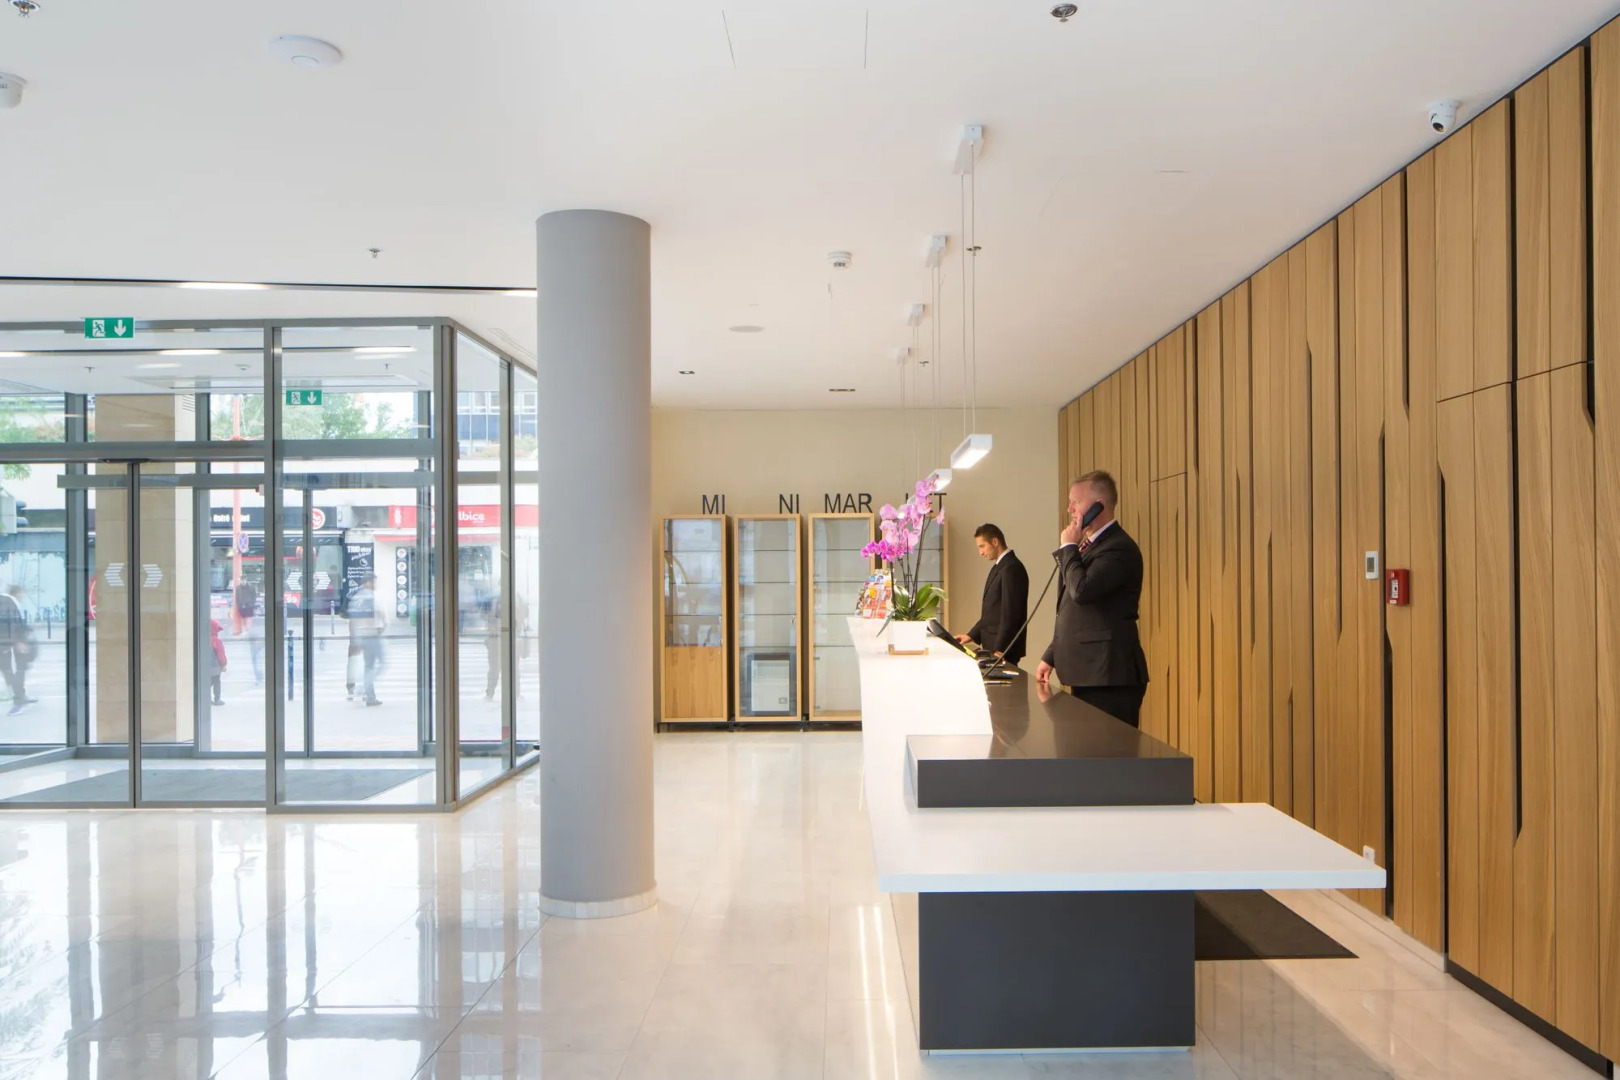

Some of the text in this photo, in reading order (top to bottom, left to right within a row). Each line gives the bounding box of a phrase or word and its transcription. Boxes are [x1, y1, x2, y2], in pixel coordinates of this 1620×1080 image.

[702, 494, 725, 514] MI
[779, 493, 799, 514] NI
[825, 493, 873, 513] MAR
